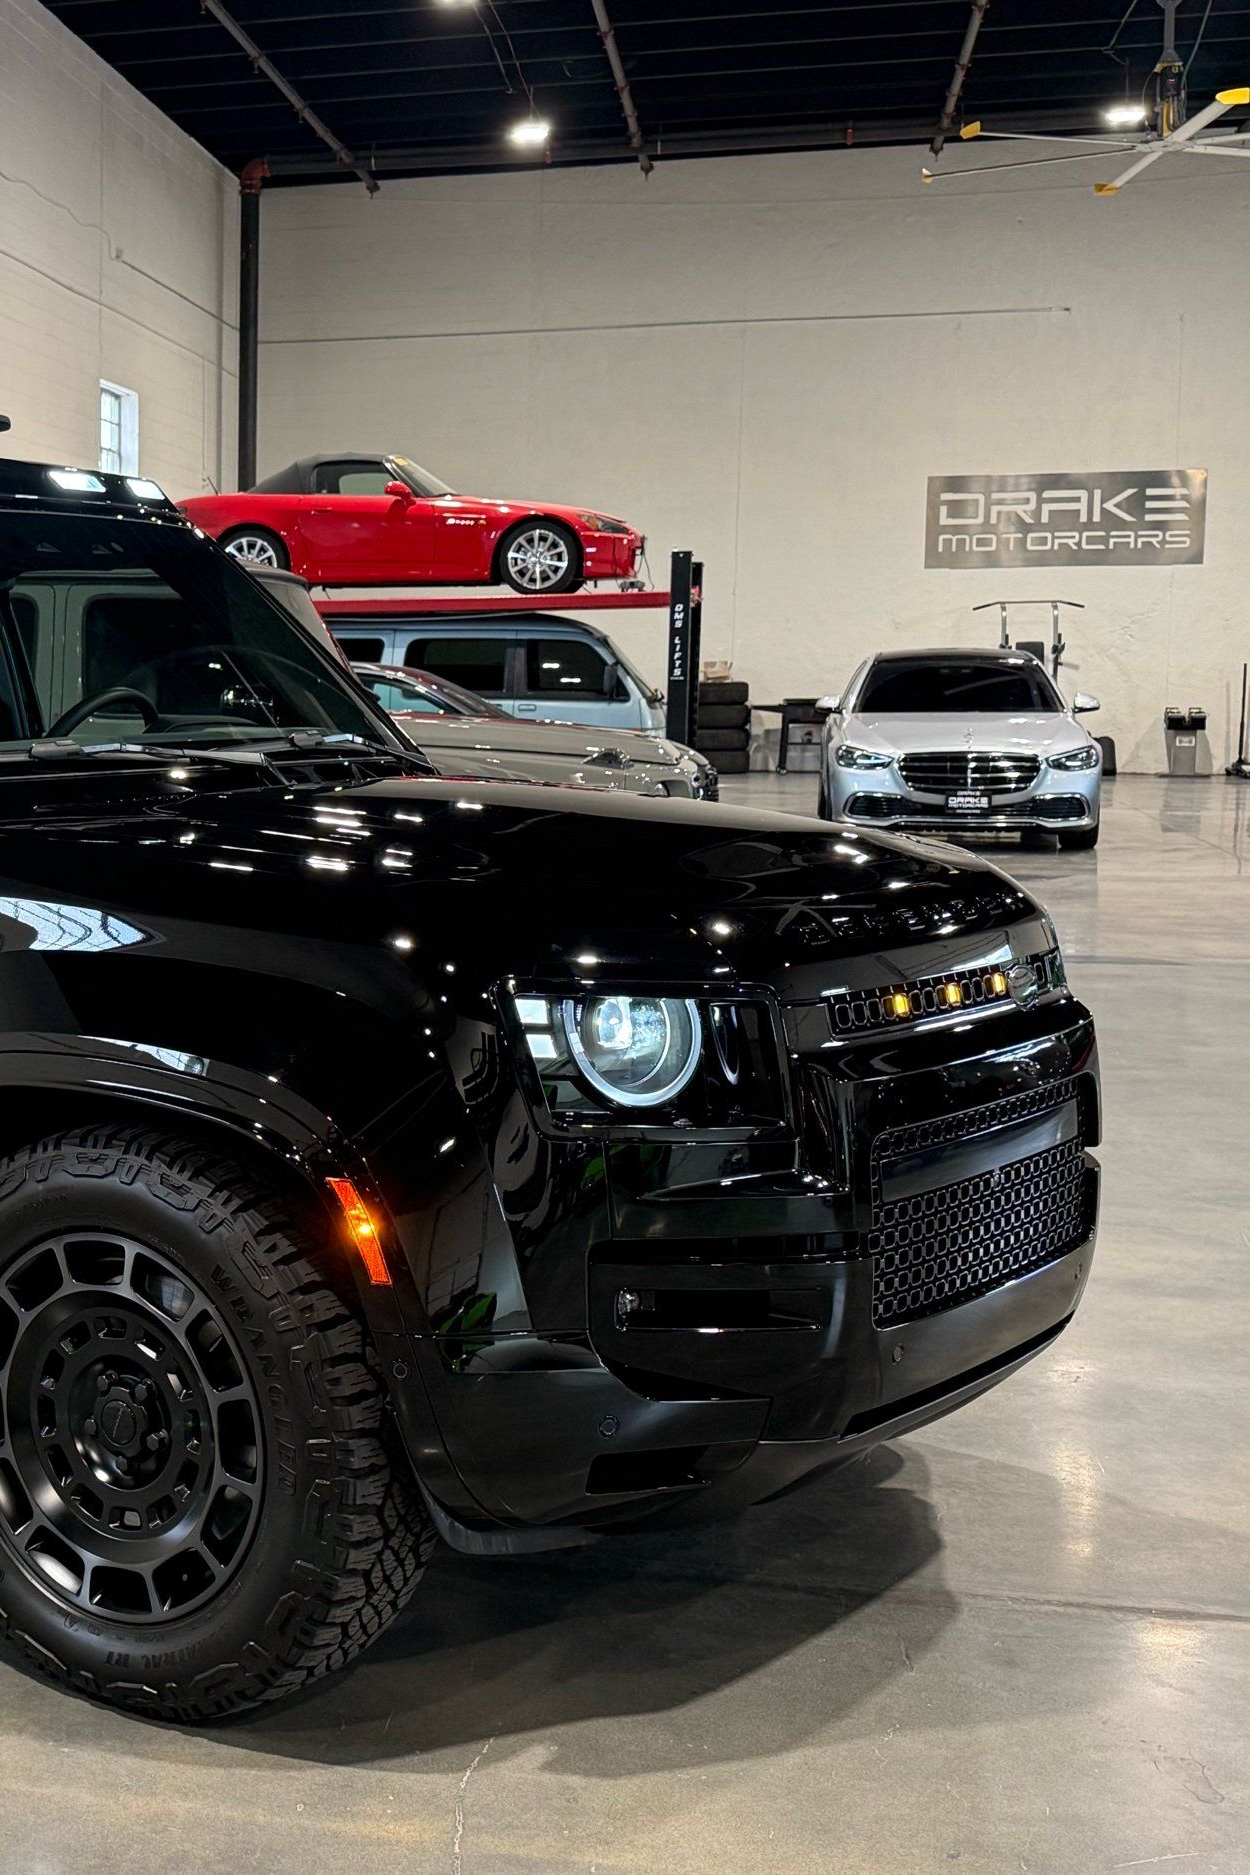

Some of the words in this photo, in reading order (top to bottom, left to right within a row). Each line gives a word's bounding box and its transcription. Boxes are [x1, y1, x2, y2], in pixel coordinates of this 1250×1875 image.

[939, 487, 1191, 526] DRAKE
[938, 530, 1191, 552] MOTORCARS
[673, 636, 683, 676] LIFTS
[211, 1264, 298, 1496] WRANGLER
